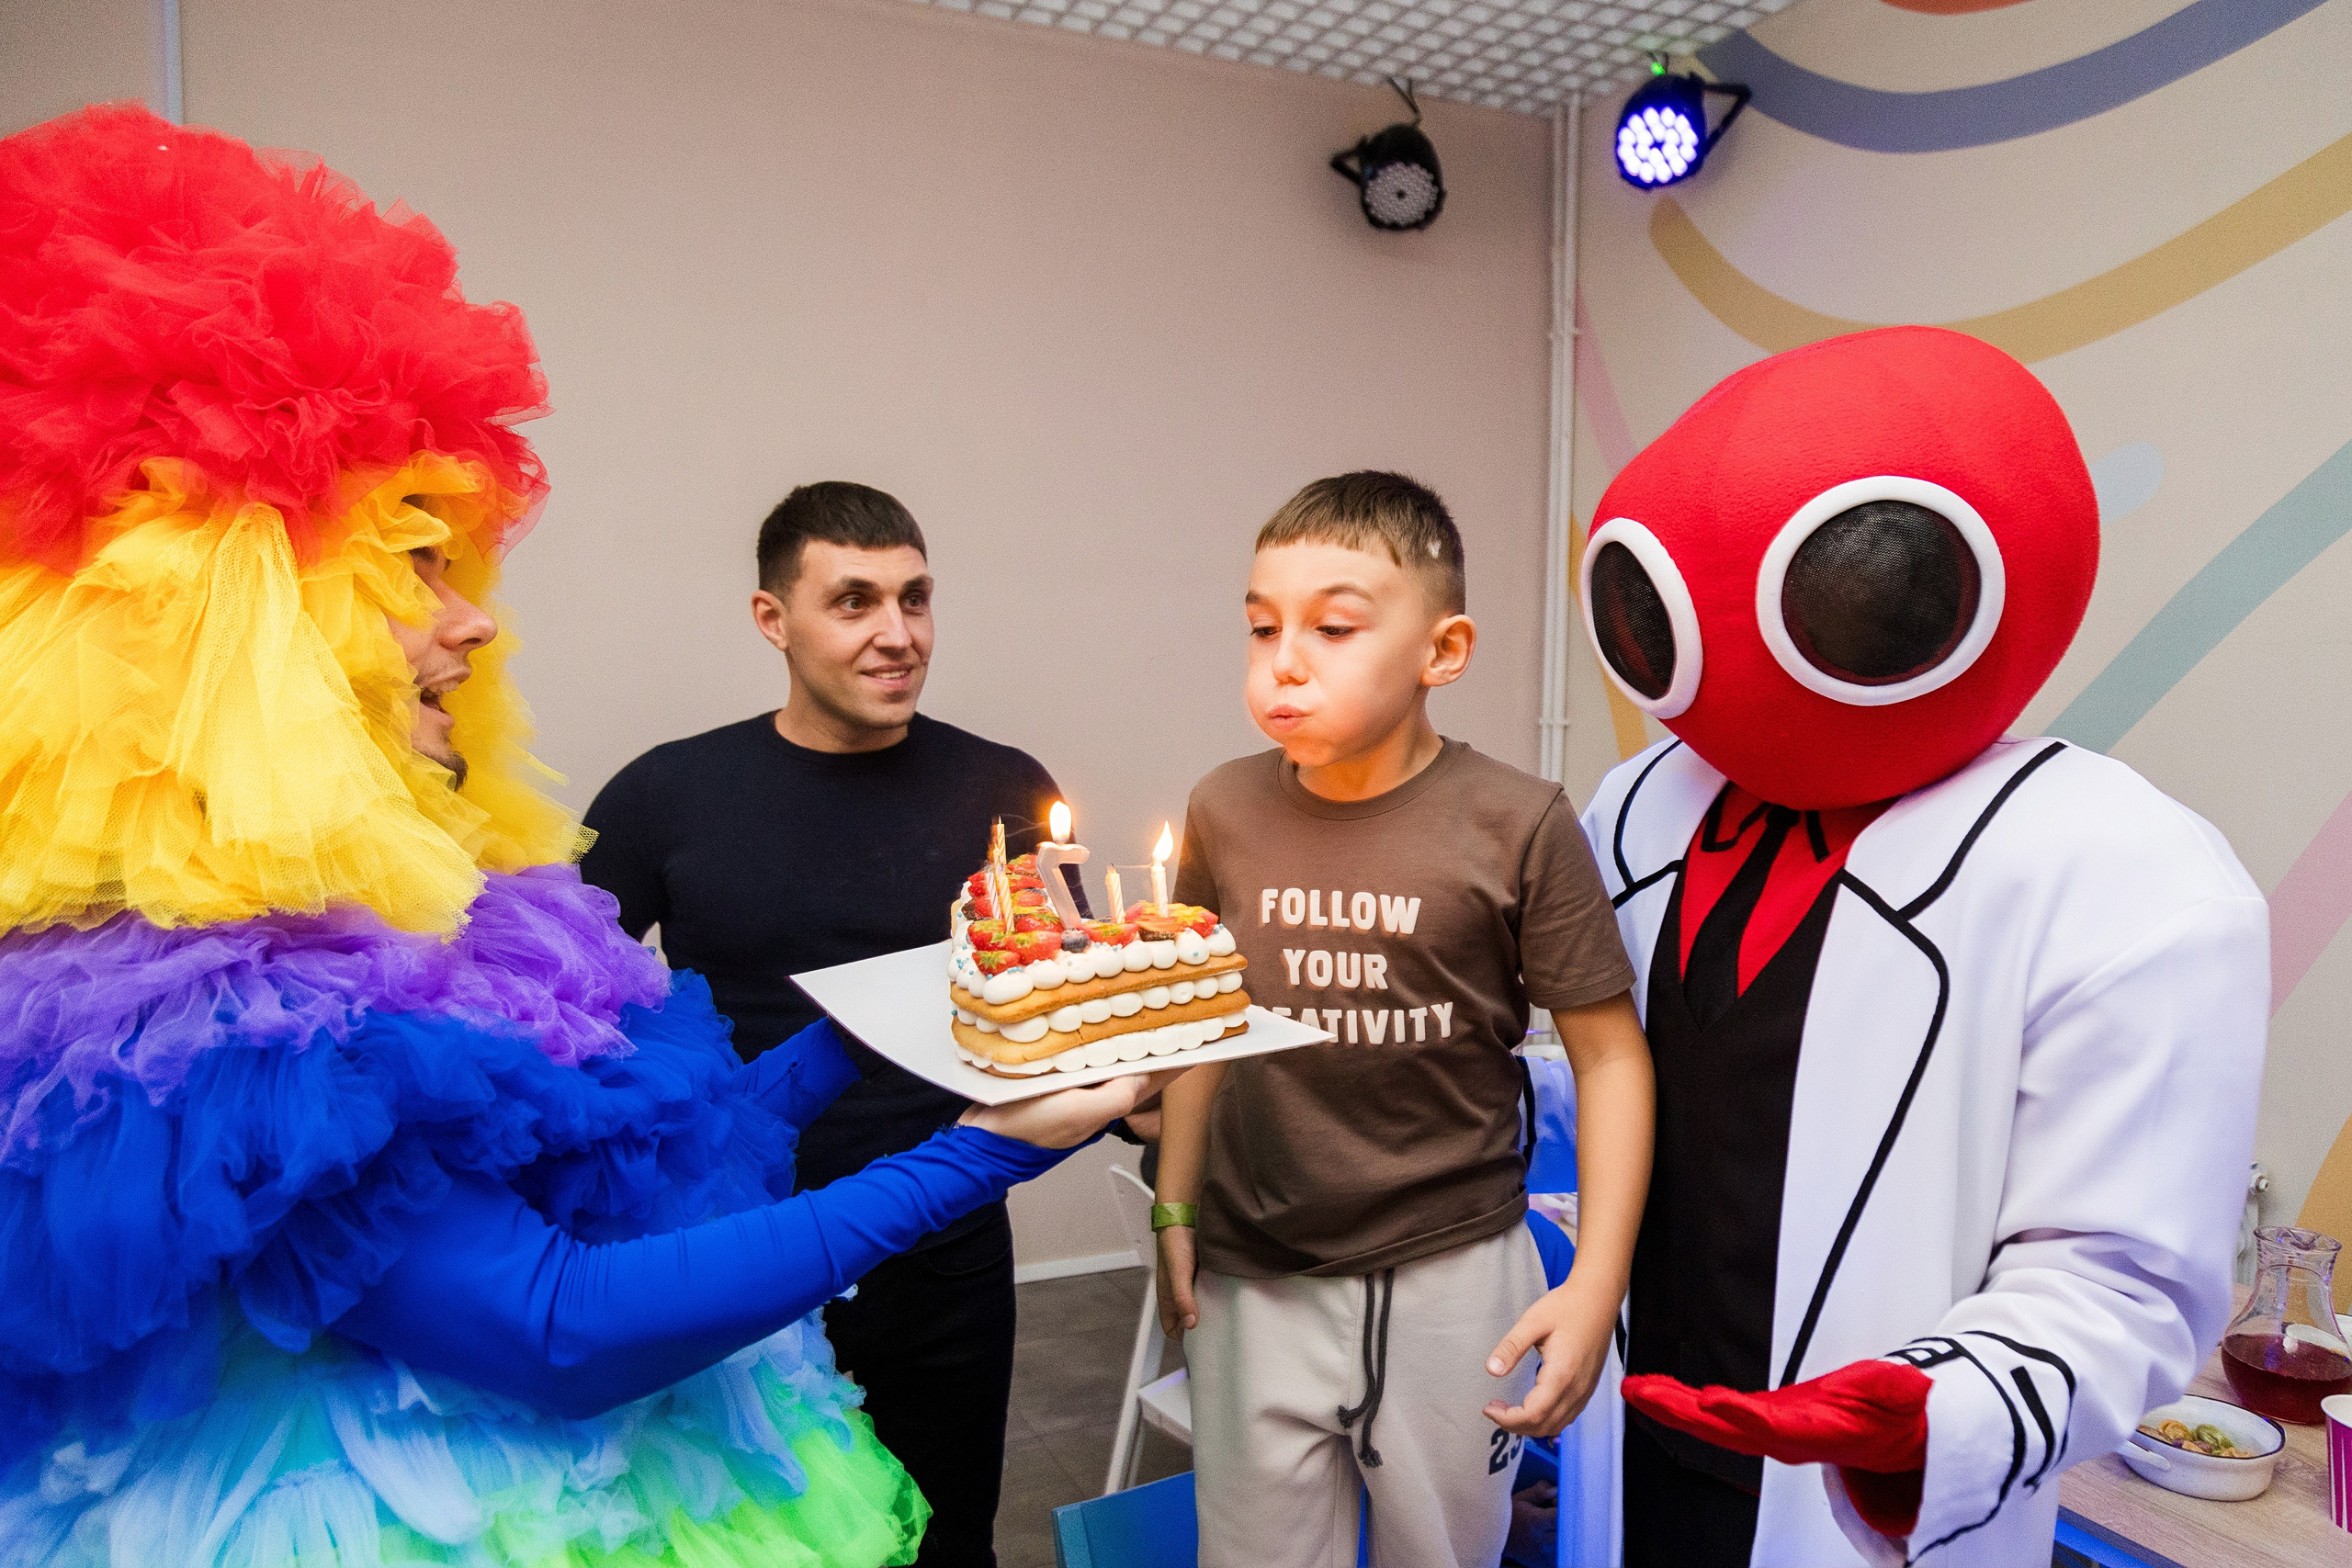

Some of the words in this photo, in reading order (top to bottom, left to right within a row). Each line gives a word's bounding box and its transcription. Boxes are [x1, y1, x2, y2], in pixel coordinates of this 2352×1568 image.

[1261, 887, 1422, 935] FOLLOW
[1283, 948, 1389, 990] YOUR
[1257, 1001, 1453, 1045] ATIVITY
